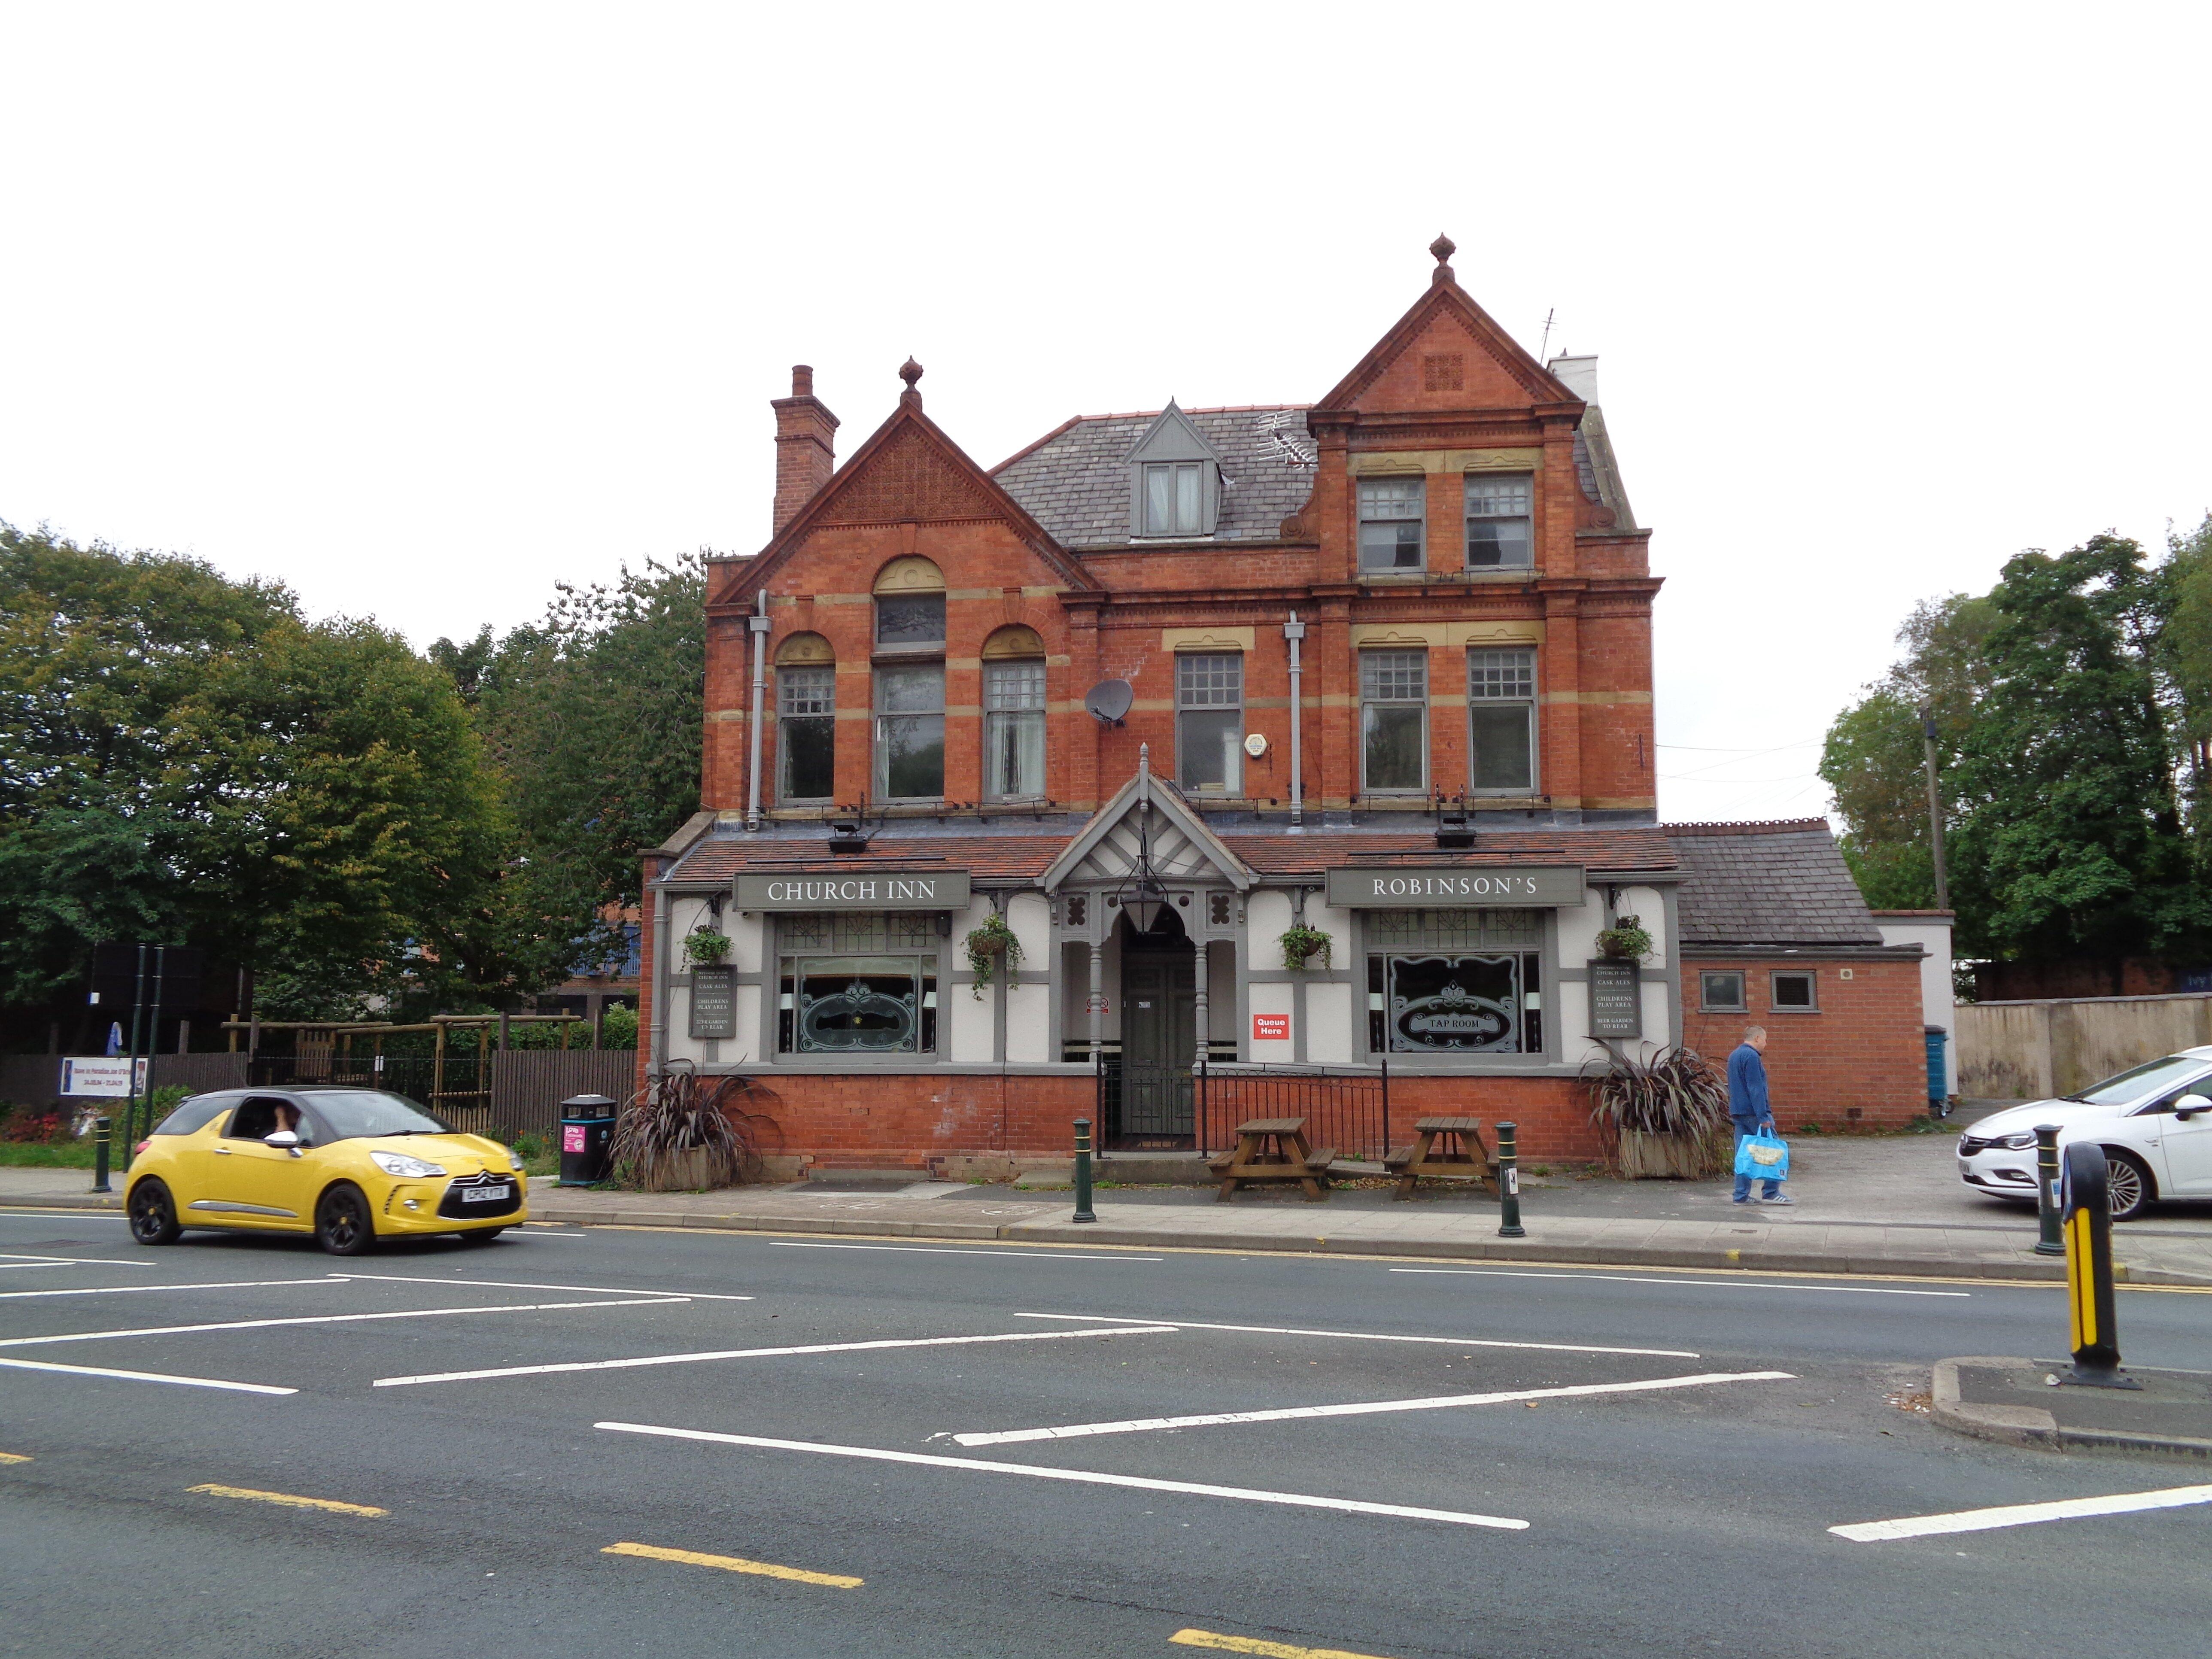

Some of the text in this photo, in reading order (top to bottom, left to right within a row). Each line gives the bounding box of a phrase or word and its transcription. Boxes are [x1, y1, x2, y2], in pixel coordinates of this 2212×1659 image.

[768, 881, 936, 900] CHURCH INN
[1373, 877, 1537, 895] ROBINSON'S
